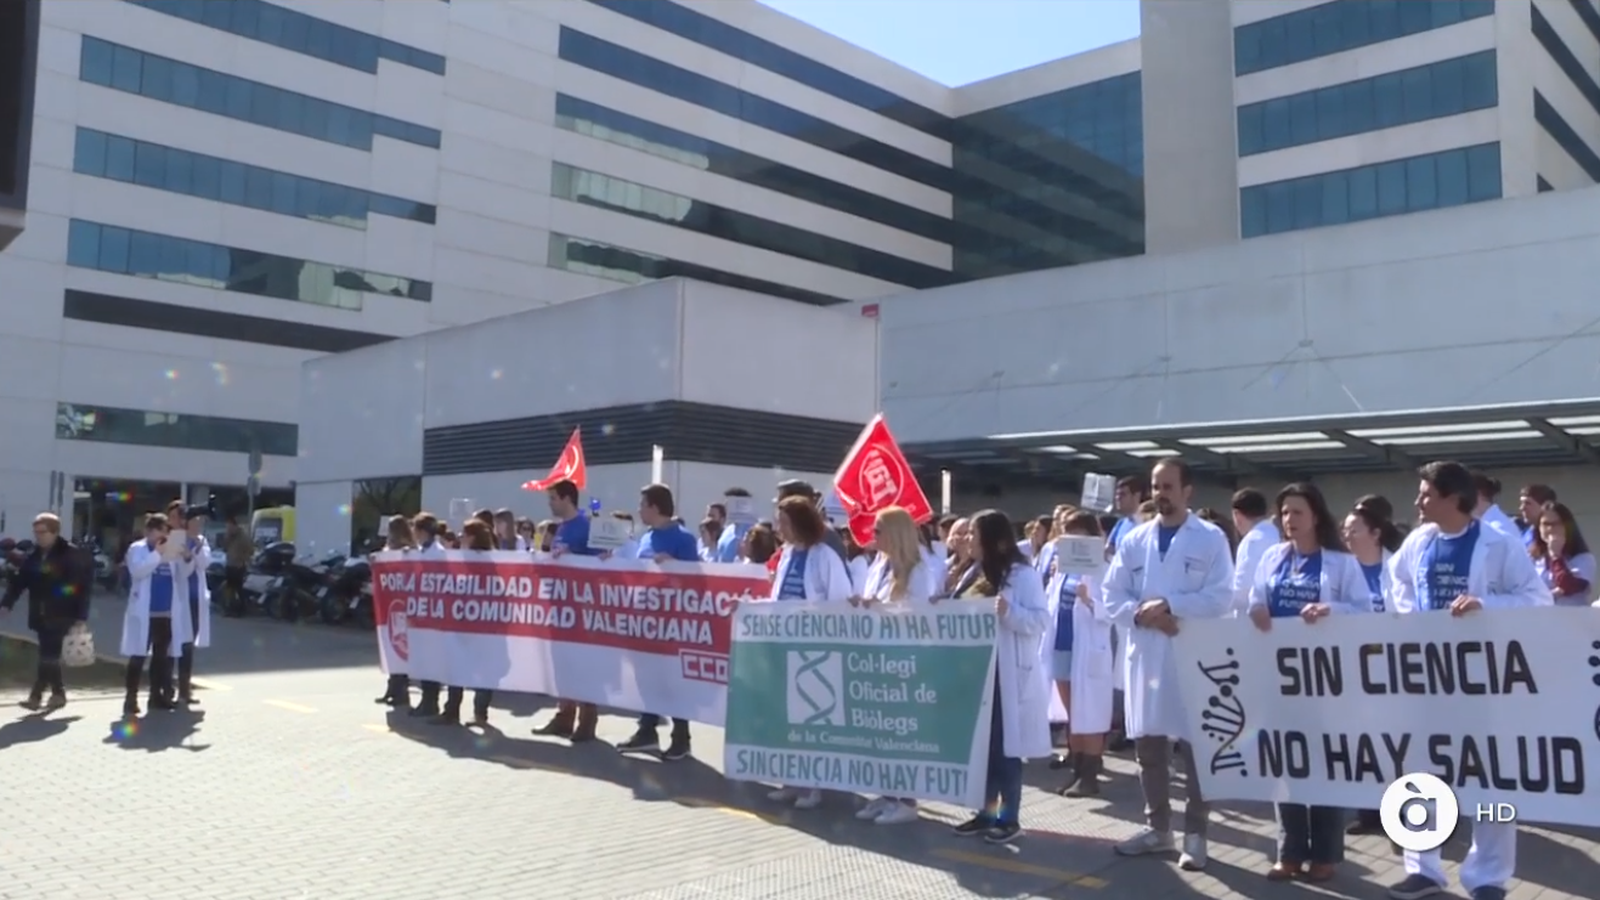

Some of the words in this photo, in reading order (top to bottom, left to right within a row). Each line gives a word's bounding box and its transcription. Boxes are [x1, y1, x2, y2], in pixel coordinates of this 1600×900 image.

[420, 573, 532, 599] ESTABILIDAD
[538, 578, 568, 601] EN
[572, 581, 595, 604] LA
[406, 597, 428, 617] DE
[452, 602, 575, 630] COMUNIDAD
[582, 610, 713, 645] VALENCIANA
[741, 614, 781, 637] SENSE
[785, 610, 848, 639] CIÈNCIA
[851, 614, 873, 640] NO
[880, 614, 901, 640] HI
[904, 614, 931, 641] HA
[936, 613, 997, 641] FUTUR
[1276, 646, 1343, 697] SIN
[1359, 640, 1539, 696] CIENCIA
[849, 680, 909, 704] Oficial
[914, 683, 938, 704] de
[851, 708, 919, 736] Biòlegs
[787, 730, 803, 743] de
[805, 731, 817, 743] la
[874, 737, 940, 754] Valenciana
[736, 750, 766, 775] SIN
[768, 753, 843, 785] CIENCIA
[848, 760, 875, 787] NO
[878, 763, 919, 793] HAY
[1257, 729, 1311, 779] NO
[1322, 732, 1412, 784] HAY
[1427, 734, 1586, 796] SALUD
